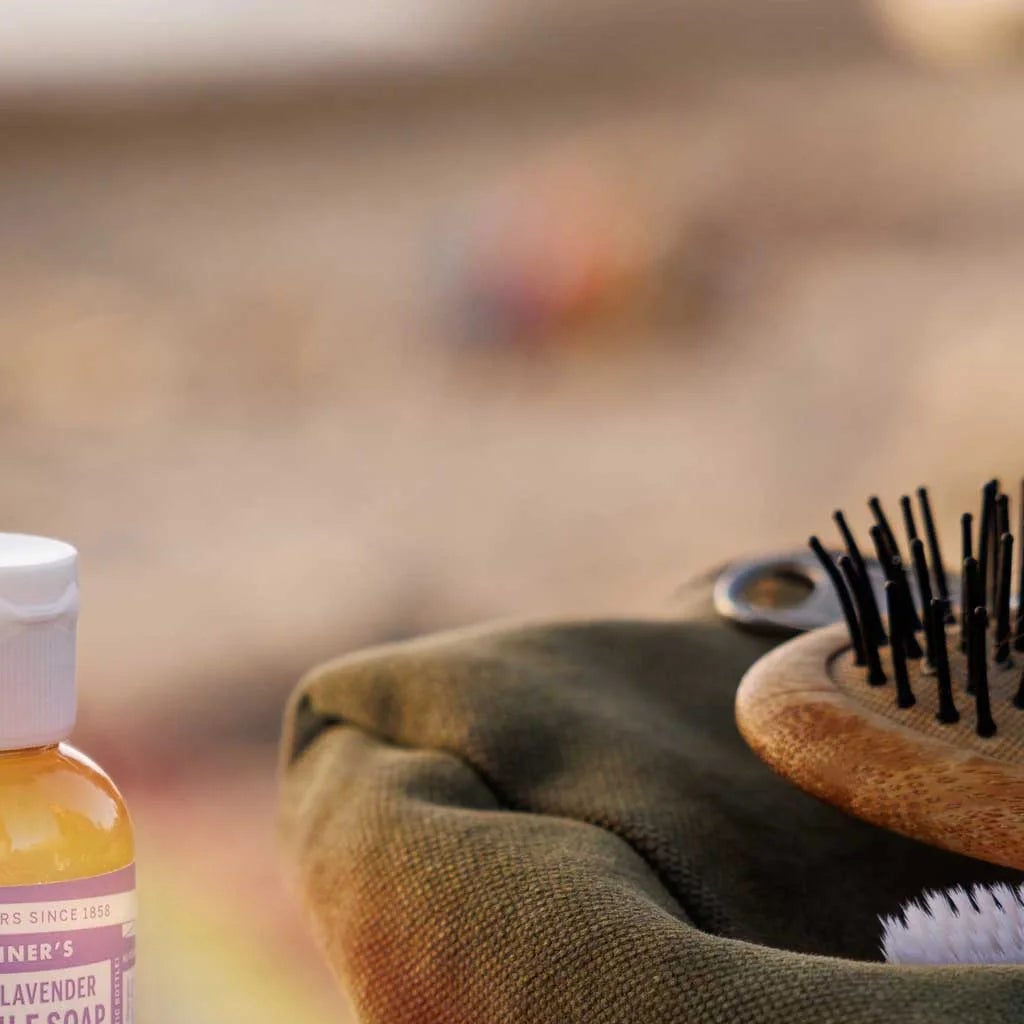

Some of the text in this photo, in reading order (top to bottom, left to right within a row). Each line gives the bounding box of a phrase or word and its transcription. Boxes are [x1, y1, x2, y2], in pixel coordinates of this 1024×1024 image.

[30, 908, 77, 924] SINCE
[83, 904, 111, 920] 1858
[0, 975, 96, 1006] LAVENDER
